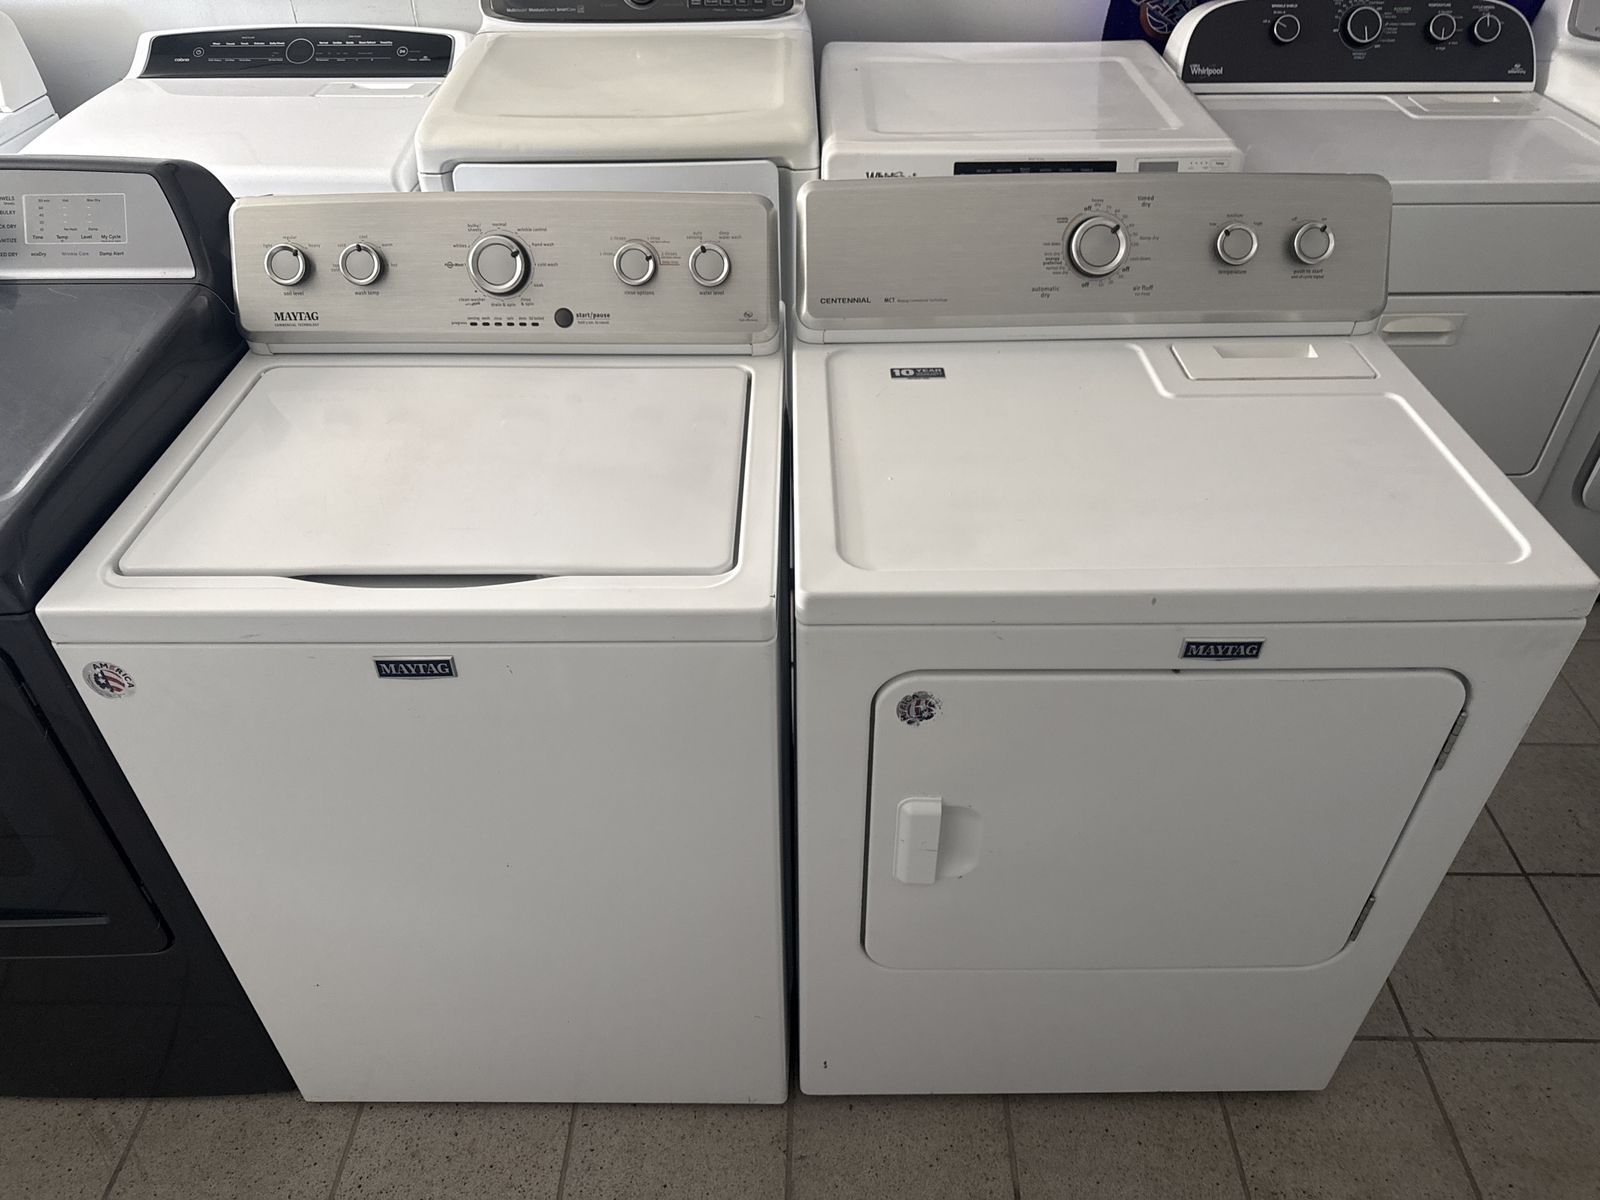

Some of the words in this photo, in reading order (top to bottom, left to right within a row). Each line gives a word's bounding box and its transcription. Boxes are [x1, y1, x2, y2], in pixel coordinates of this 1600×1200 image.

[1190, 66, 1223, 77] Whirlpool
[820, 297, 872, 305] CENTENNIAL
[273, 311, 319, 322] MAYTAG
[576, 311, 611, 320] start/pause
[1187, 644, 1258, 656] MAYTAG
[379, 663, 450, 675] MAYTAG
